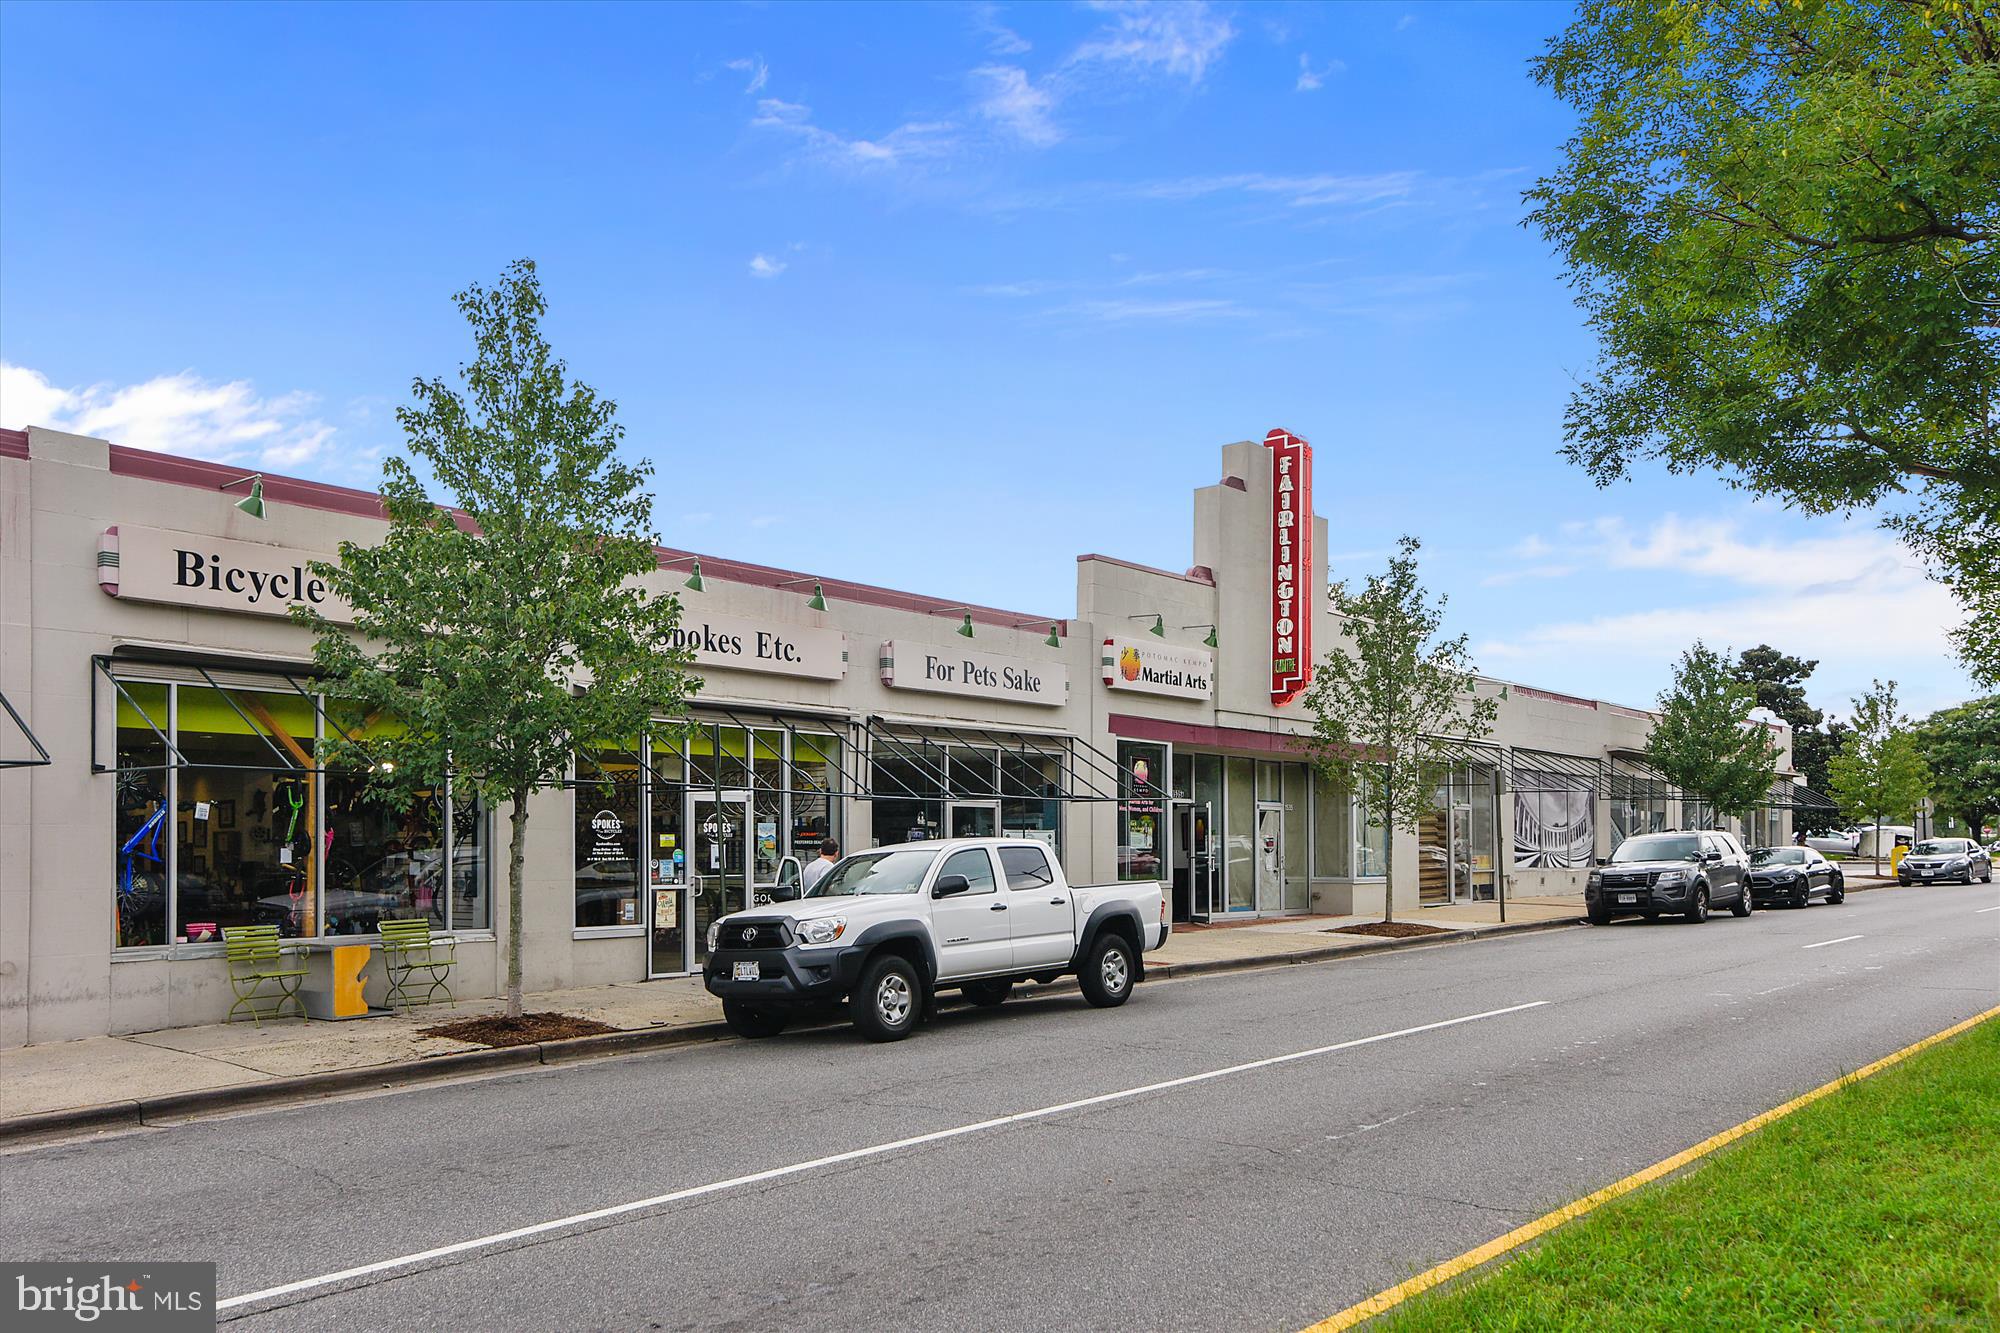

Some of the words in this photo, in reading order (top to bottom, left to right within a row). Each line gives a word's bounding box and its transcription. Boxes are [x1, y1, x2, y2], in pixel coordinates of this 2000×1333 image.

[1276, 456, 1294, 654] FAIRLINGTON
[172, 549, 325, 603] Bicycle
[756, 631, 801, 663] Etc.
[1141, 652, 1179, 664] POTOMAC
[1183, 659, 1207, 668] KEMPO
[925, 655, 955, 682] For
[962, 660, 997, 687] Pets
[1003, 666, 1041, 692] Sake
[1141, 666, 1182, 686] Martial
[1184, 673, 1207, 690] Arts
[592, 819, 620, 829] SPOKES
[703, 822, 731, 833] SPOES
